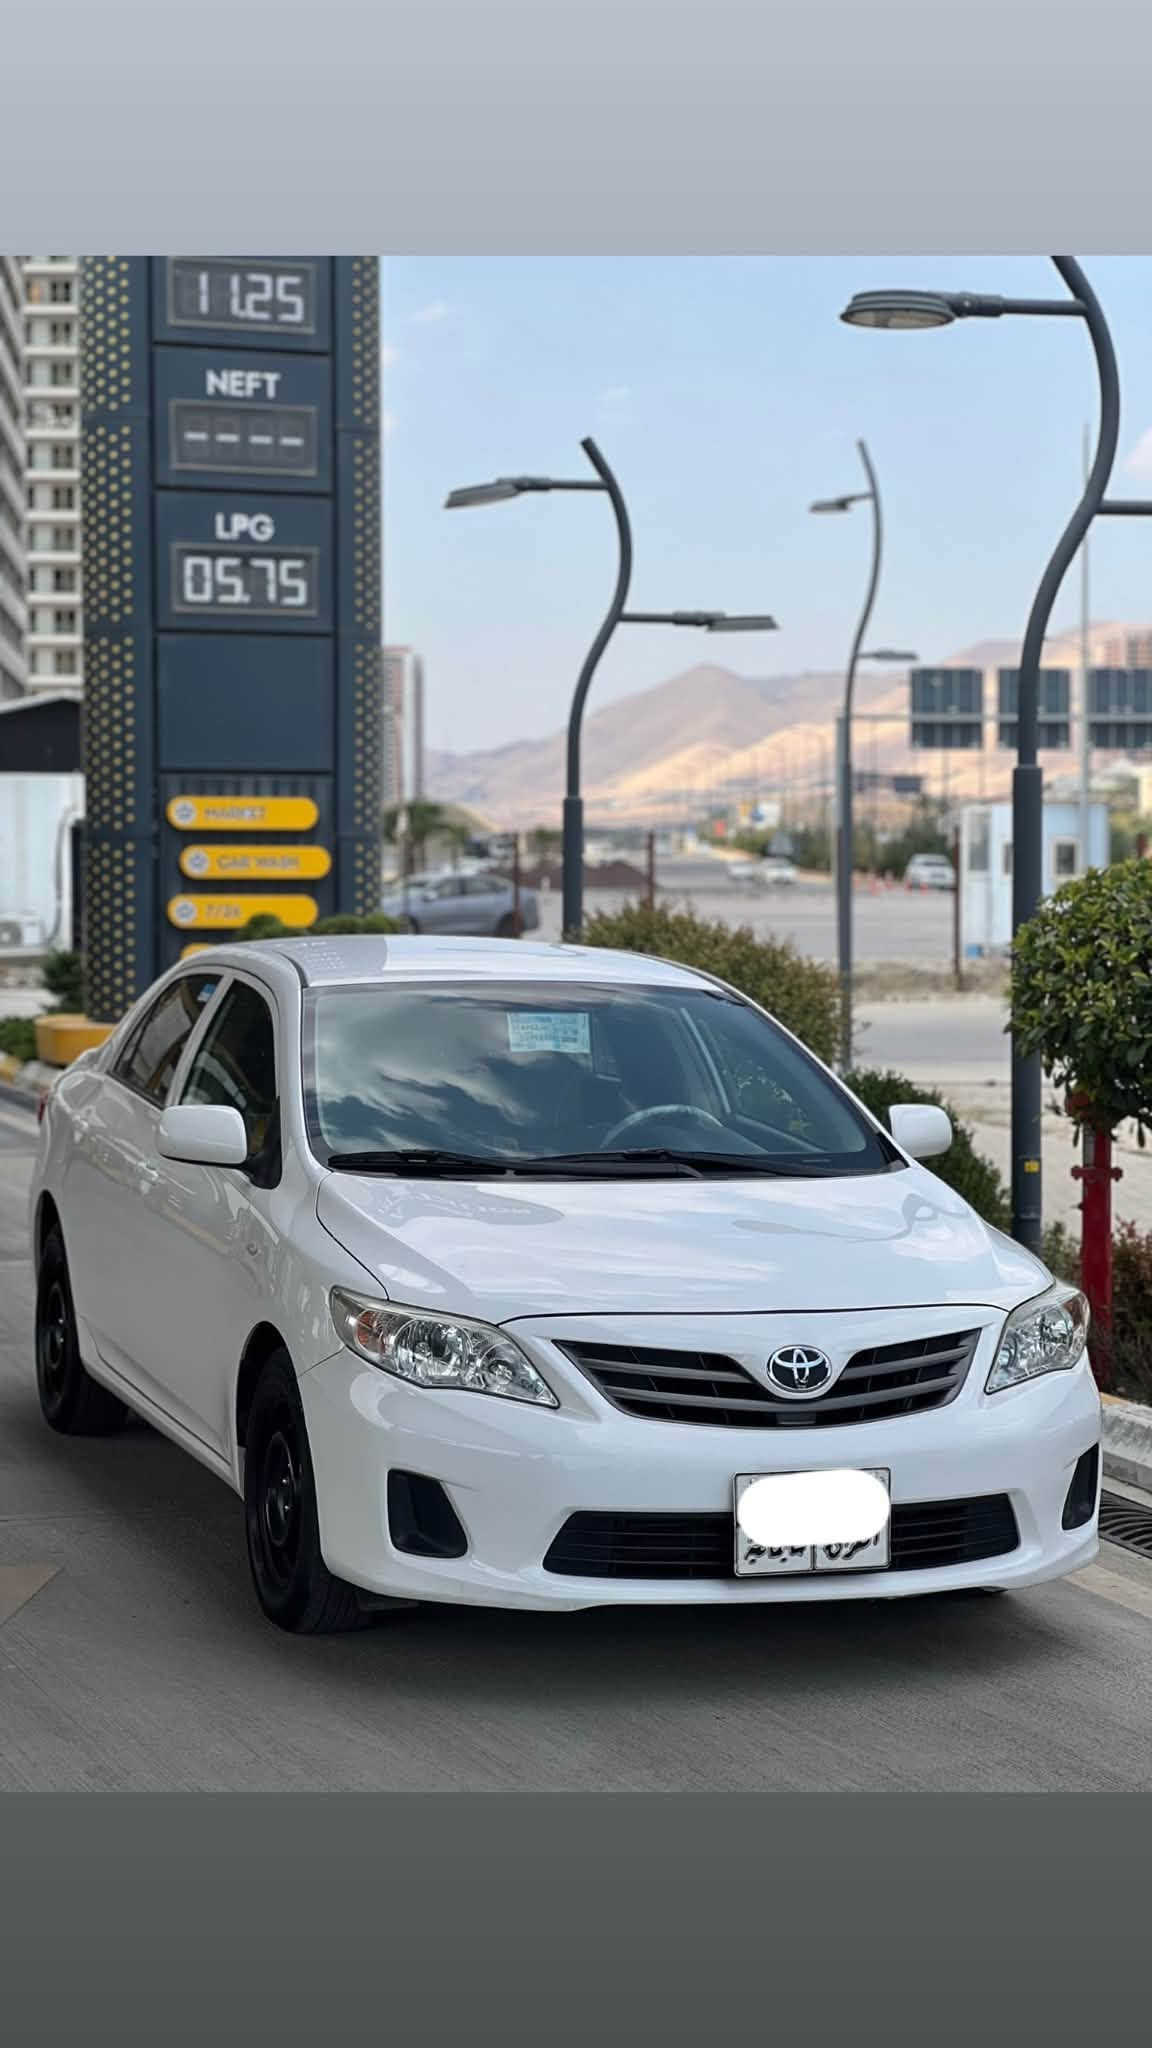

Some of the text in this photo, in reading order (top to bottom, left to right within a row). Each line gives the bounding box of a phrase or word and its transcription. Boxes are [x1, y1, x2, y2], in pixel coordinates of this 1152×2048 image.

[206, 369, 281, 399] NEFT
[214, 512, 275, 542] LPG
[184, 555, 307, 606] 05.75
[205, 806, 266, 821] MARKET
[217, 854, 299, 870] CAR WASH
